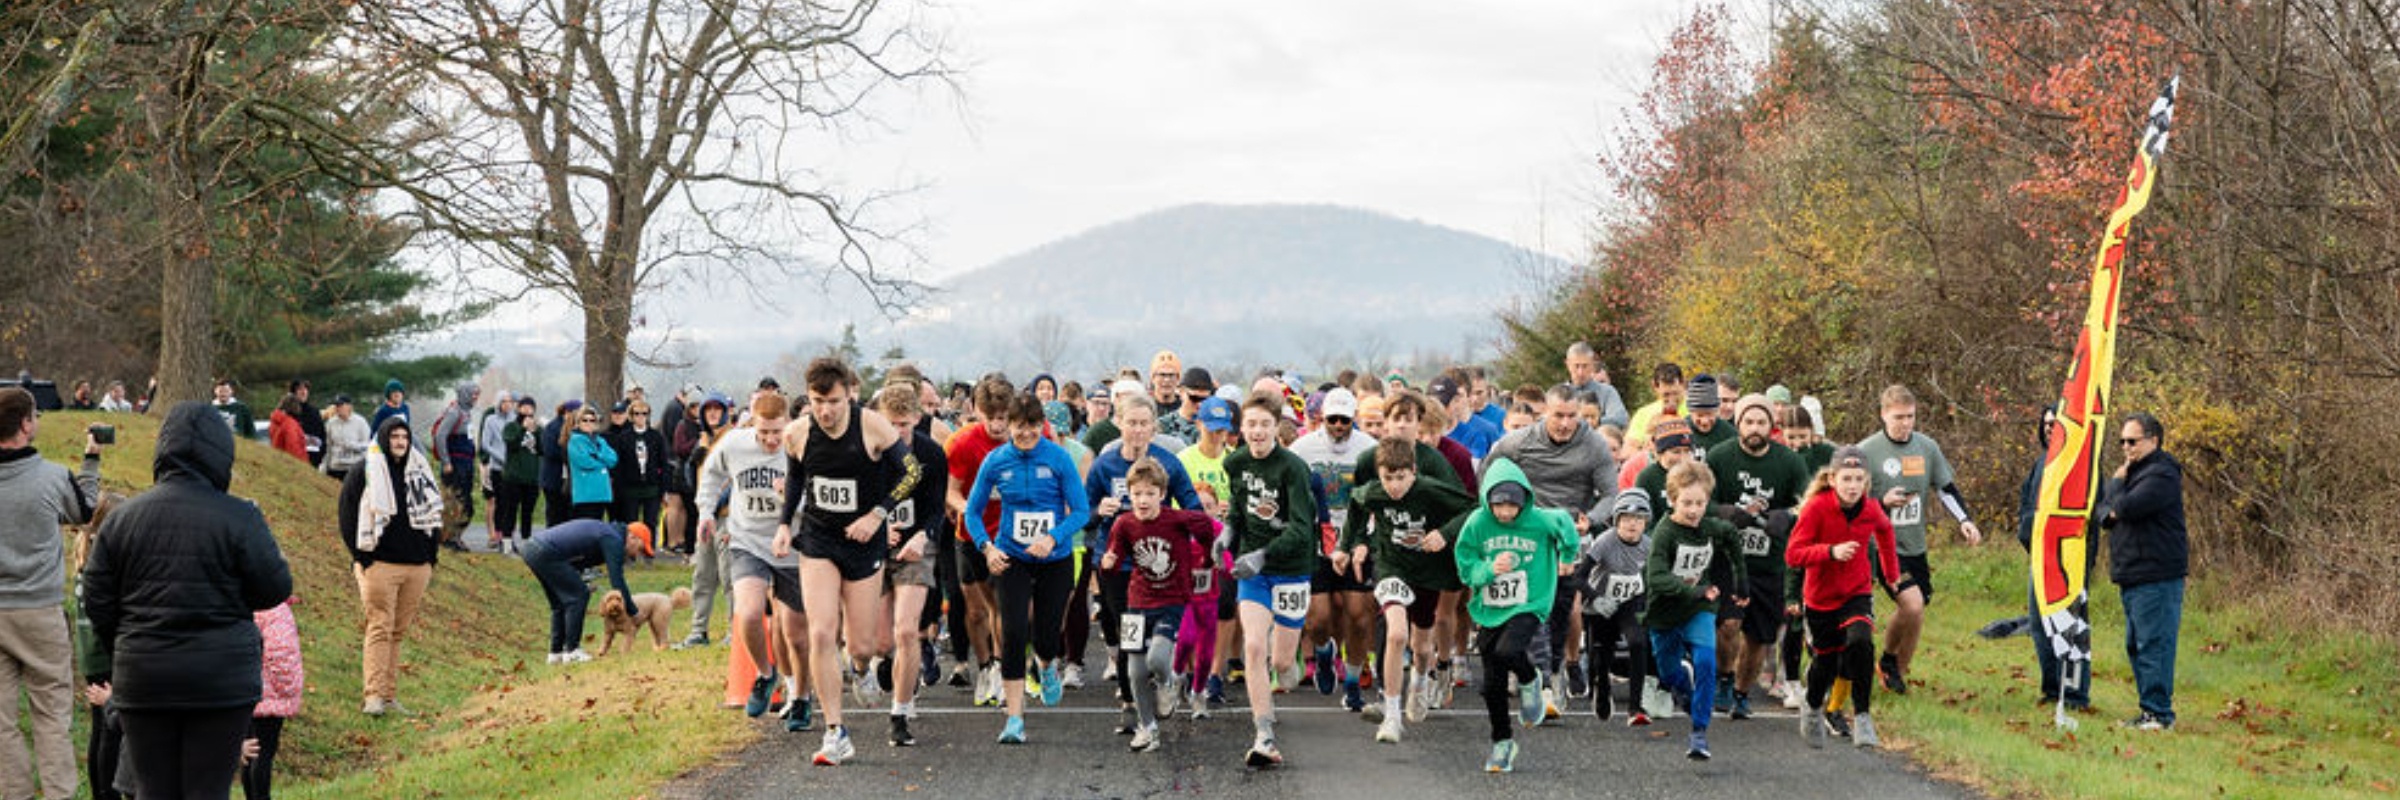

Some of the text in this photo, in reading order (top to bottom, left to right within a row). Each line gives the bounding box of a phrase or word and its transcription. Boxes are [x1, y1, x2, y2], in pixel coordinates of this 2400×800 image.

[819, 485, 850, 505] 603
[1020, 519, 1049, 537] 574
[1489, 579, 1520, 600] 637
